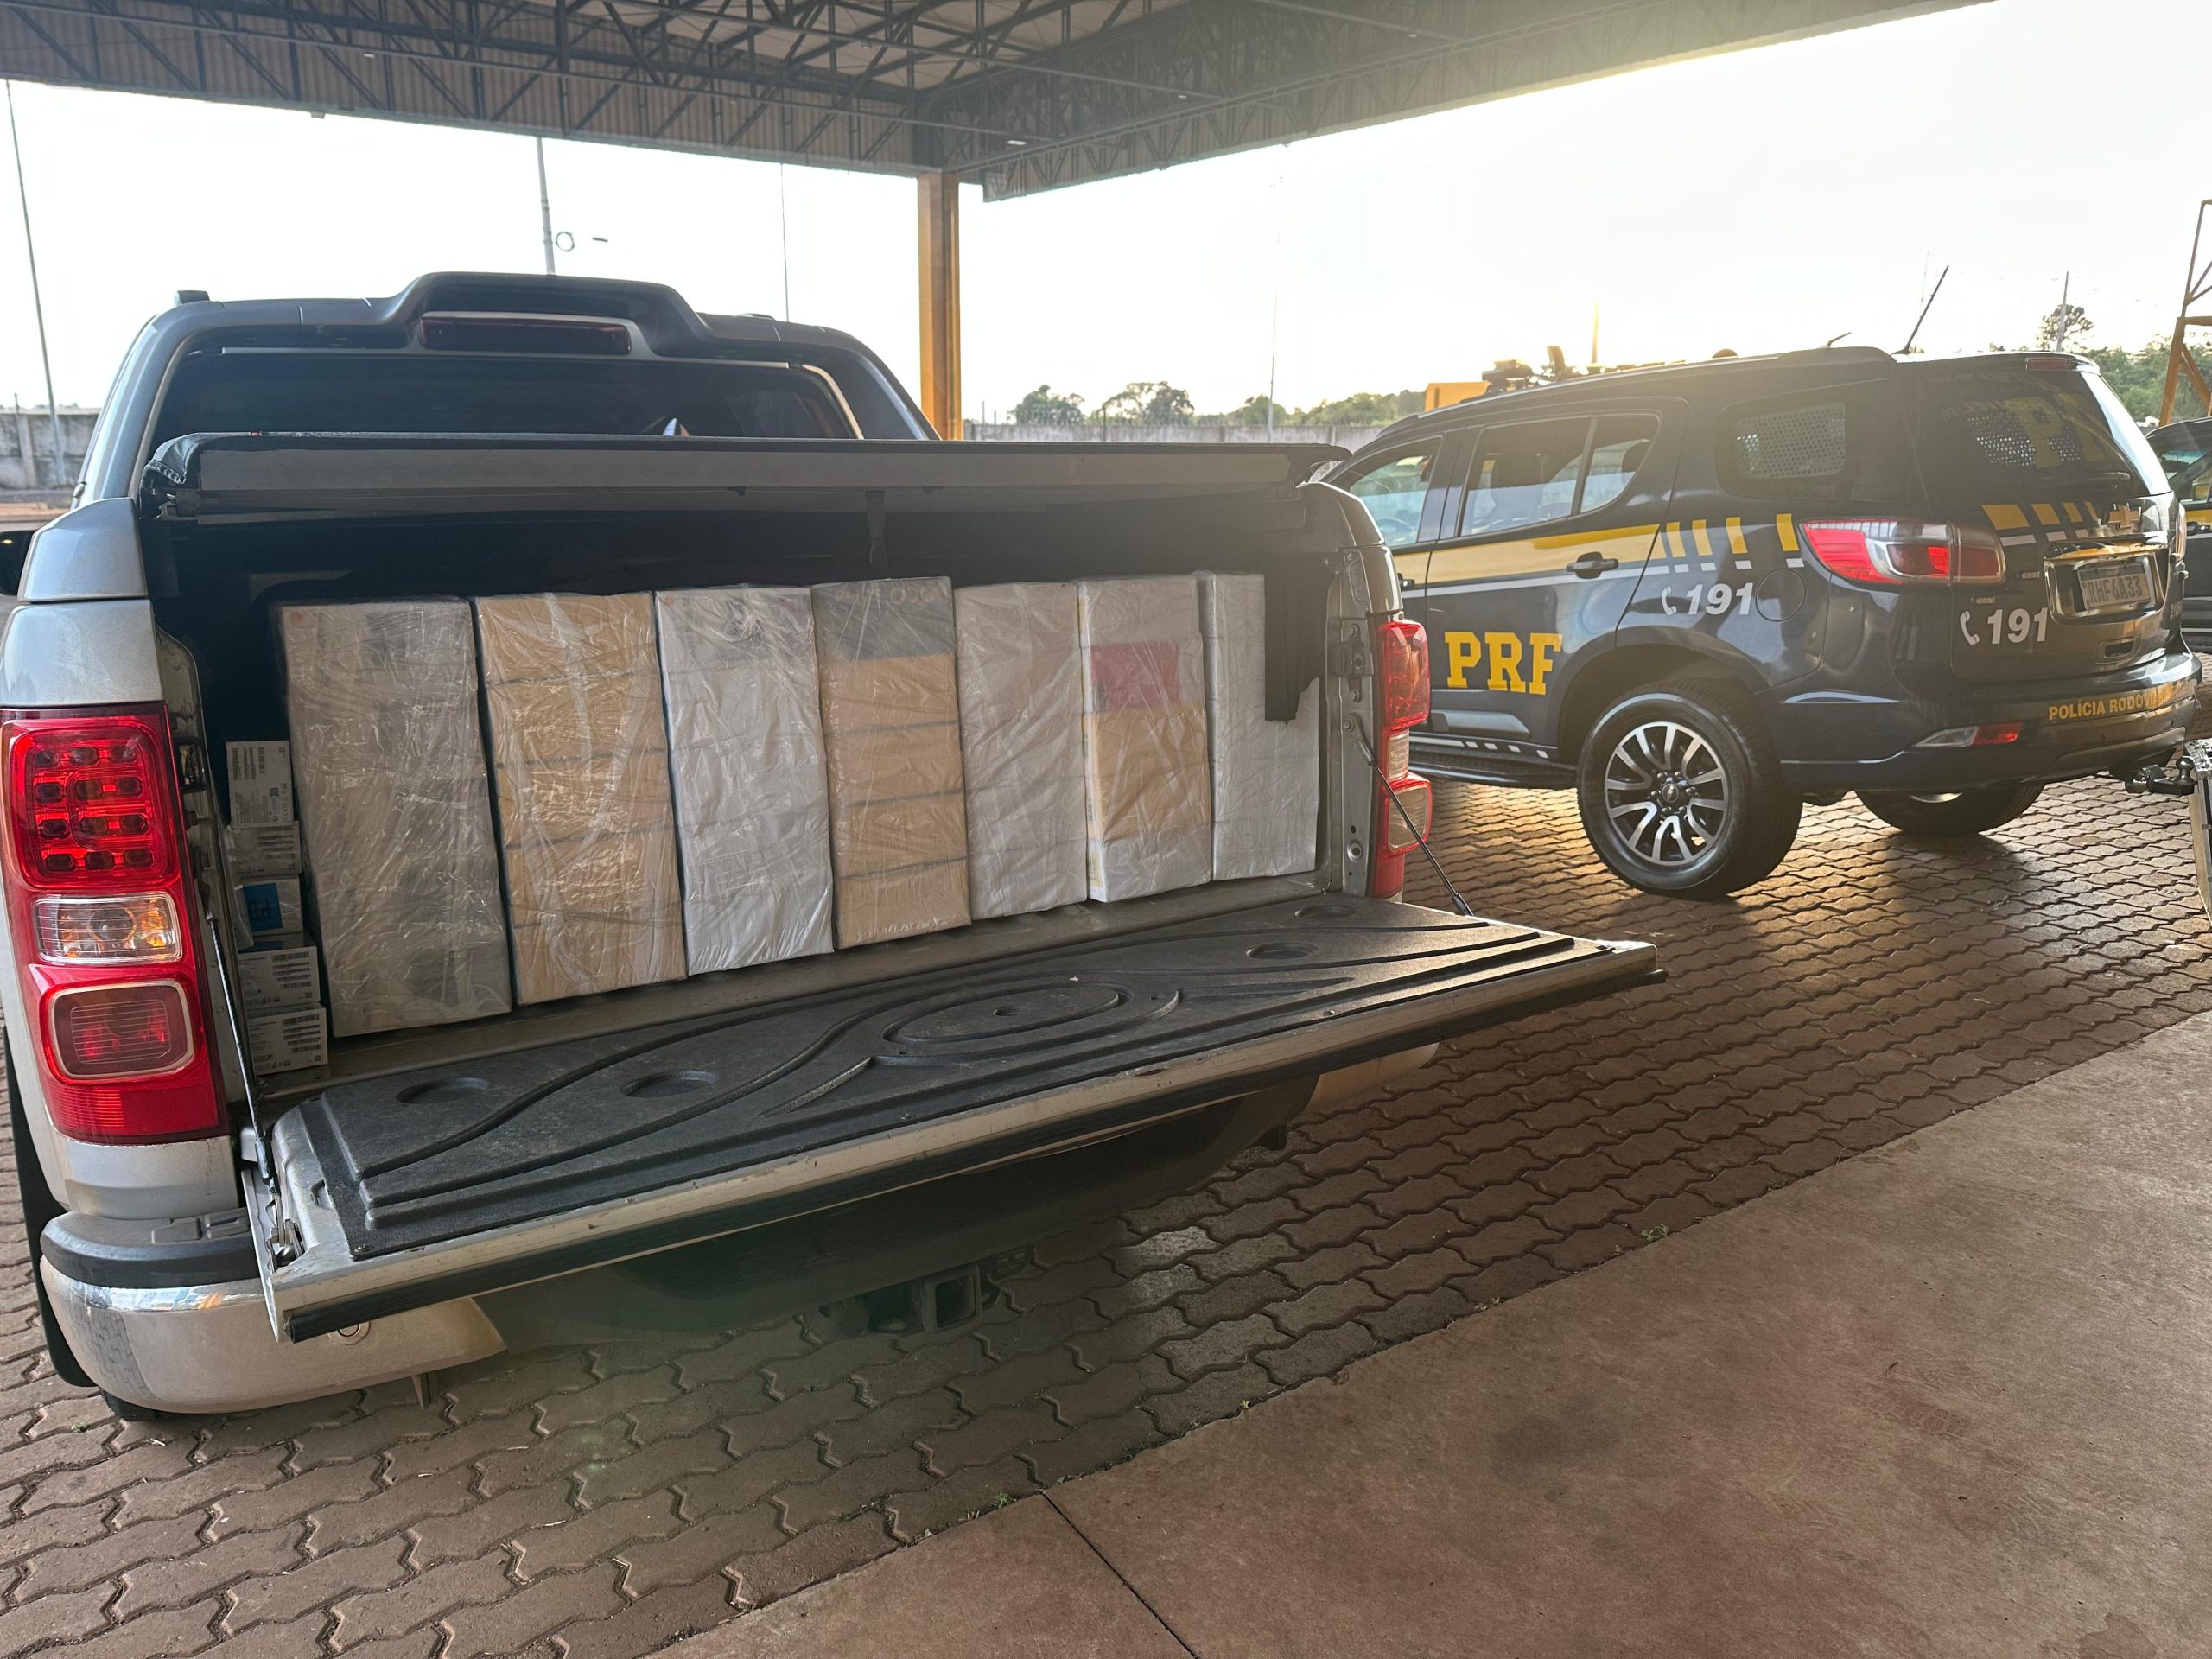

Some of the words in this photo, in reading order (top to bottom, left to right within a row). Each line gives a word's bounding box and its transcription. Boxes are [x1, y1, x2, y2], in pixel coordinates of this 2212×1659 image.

[1686, 582, 1753, 616] 191
[1987, 607, 2048, 645] 191
[1444, 632, 1563, 696] PRF
[2048, 698, 2107, 721] POLÍCIA
